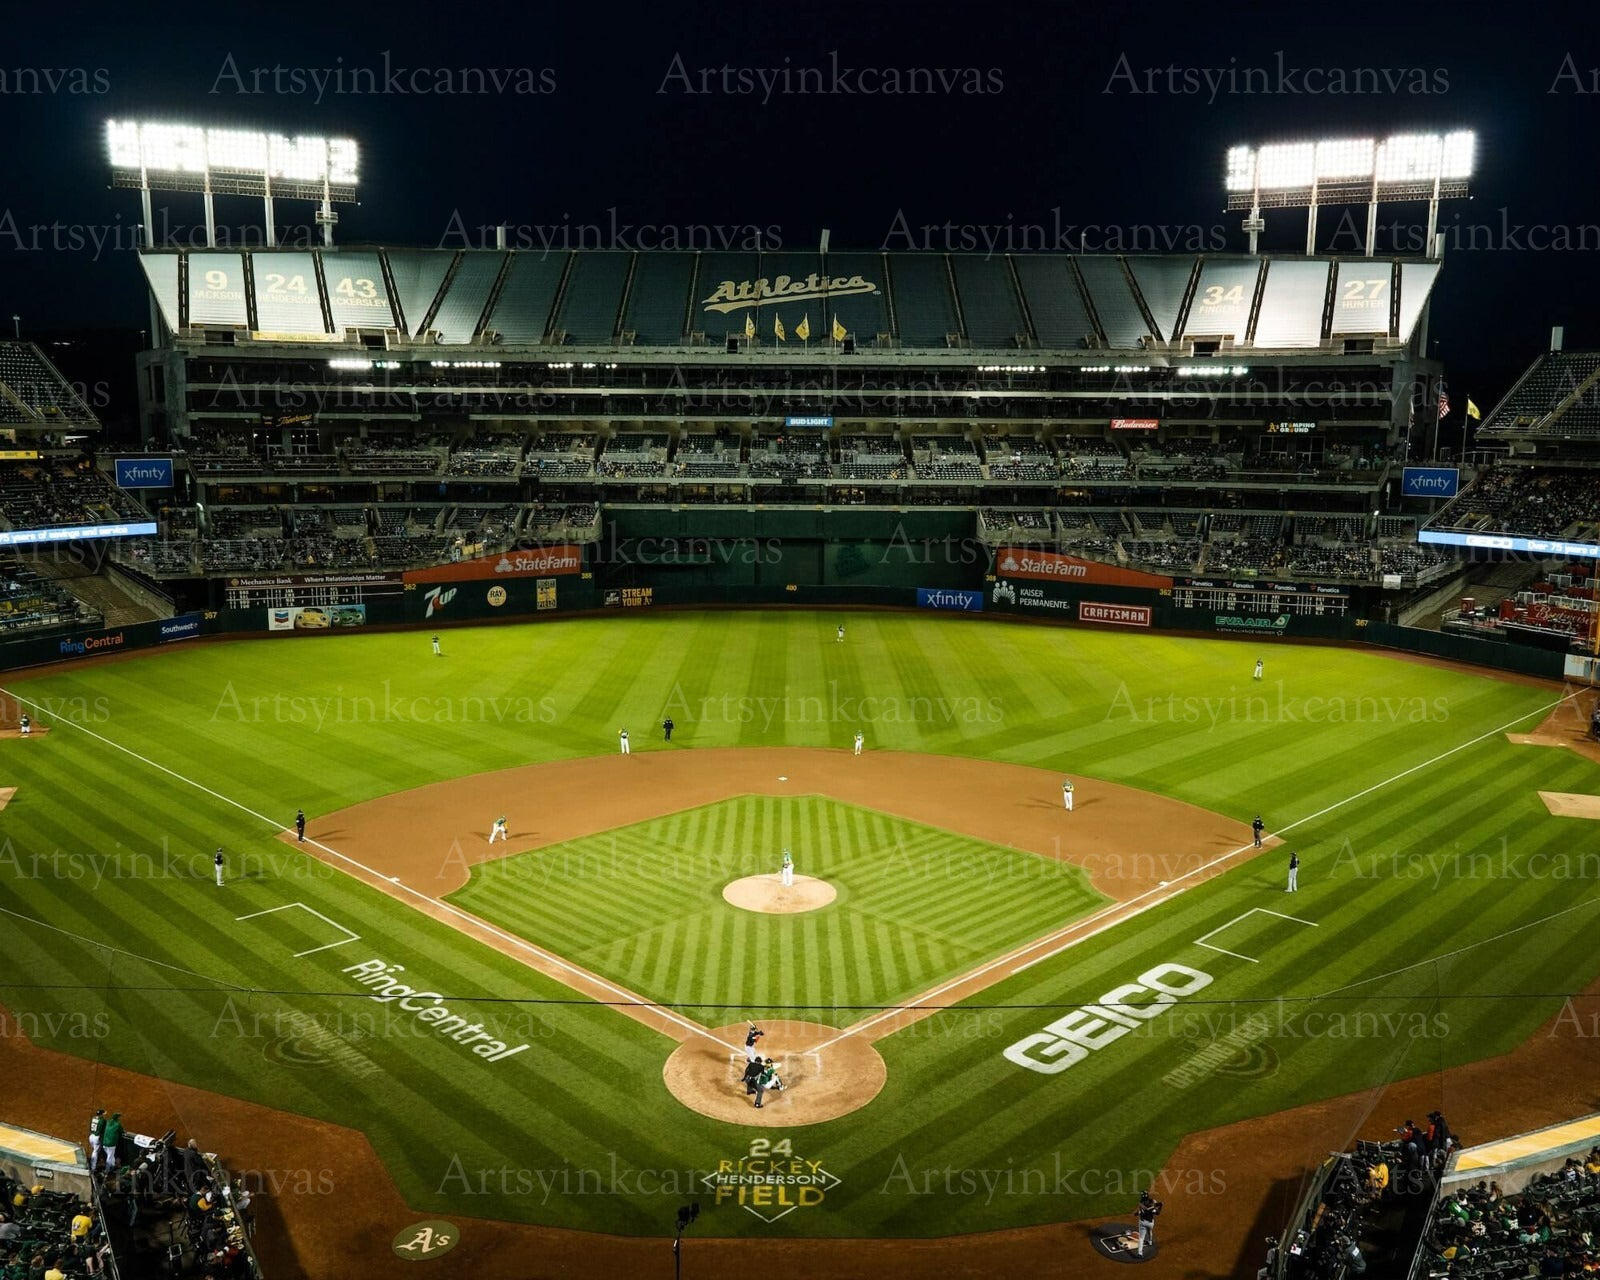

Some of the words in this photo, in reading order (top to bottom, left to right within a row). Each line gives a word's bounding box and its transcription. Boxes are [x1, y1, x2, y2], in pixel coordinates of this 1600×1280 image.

[205, 270, 227, 290] 9
[265, 274, 308, 295] 24
[336, 278, 377, 299] 43
[702, 273, 872, 305] Athletics
[1344, 280, 1387, 300] 27
[192, 291, 243, 300] JACKSON
[258, 293, 319, 304] HENDERSON
[1203, 285, 1244, 305] 34
[331, 296, 387, 308] ECKERSLEY
[1342, 299, 1385, 309] HUNTER
[1199, 304, 1241, 314] FINGERS
[1112, 419, 1157, 429] Budweiser
[124, 466, 166, 481] xfinity
[1409, 475, 1451, 491] xfinity
[240, 578, 275, 586] Mechanics
[276, 578, 293, 586] Bank
[304, 576, 324, 584] Where
[325, 575, 365, 583] Relationships
[1192, 580, 1213, 588] Fanatics
[1232, 582, 1255, 590] Fanatics
[1274, 584, 1297, 592] Fanatics
[1317, 586, 1340, 594] Fanatics
[490, 589, 503, 598] RAY
[622, 588, 652, 598] STREAM
[1019, 588, 1044, 598] KAISER
[622, 597, 642, 607] YOUR
[927, 590, 973, 610] xfinity
[1019, 597, 1069, 609] PERMANENTE
[1083, 607, 1146, 623] CRAFTSMAN
[161, 623, 194, 634] Southwest
[59, 631, 124, 655] RingCentral
[343, 958, 530, 1063] RingCentral
[1002, 962, 1213, 1074] GEICO
[749, 1138, 793, 1158] 24
[719, 1160, 823, 1174] RICKEY
[716, 1174, 826, 1185] HENDERSON
[714, 1186, 825, 1206] FIELD
[395, 1227, 451, 1253] A's
